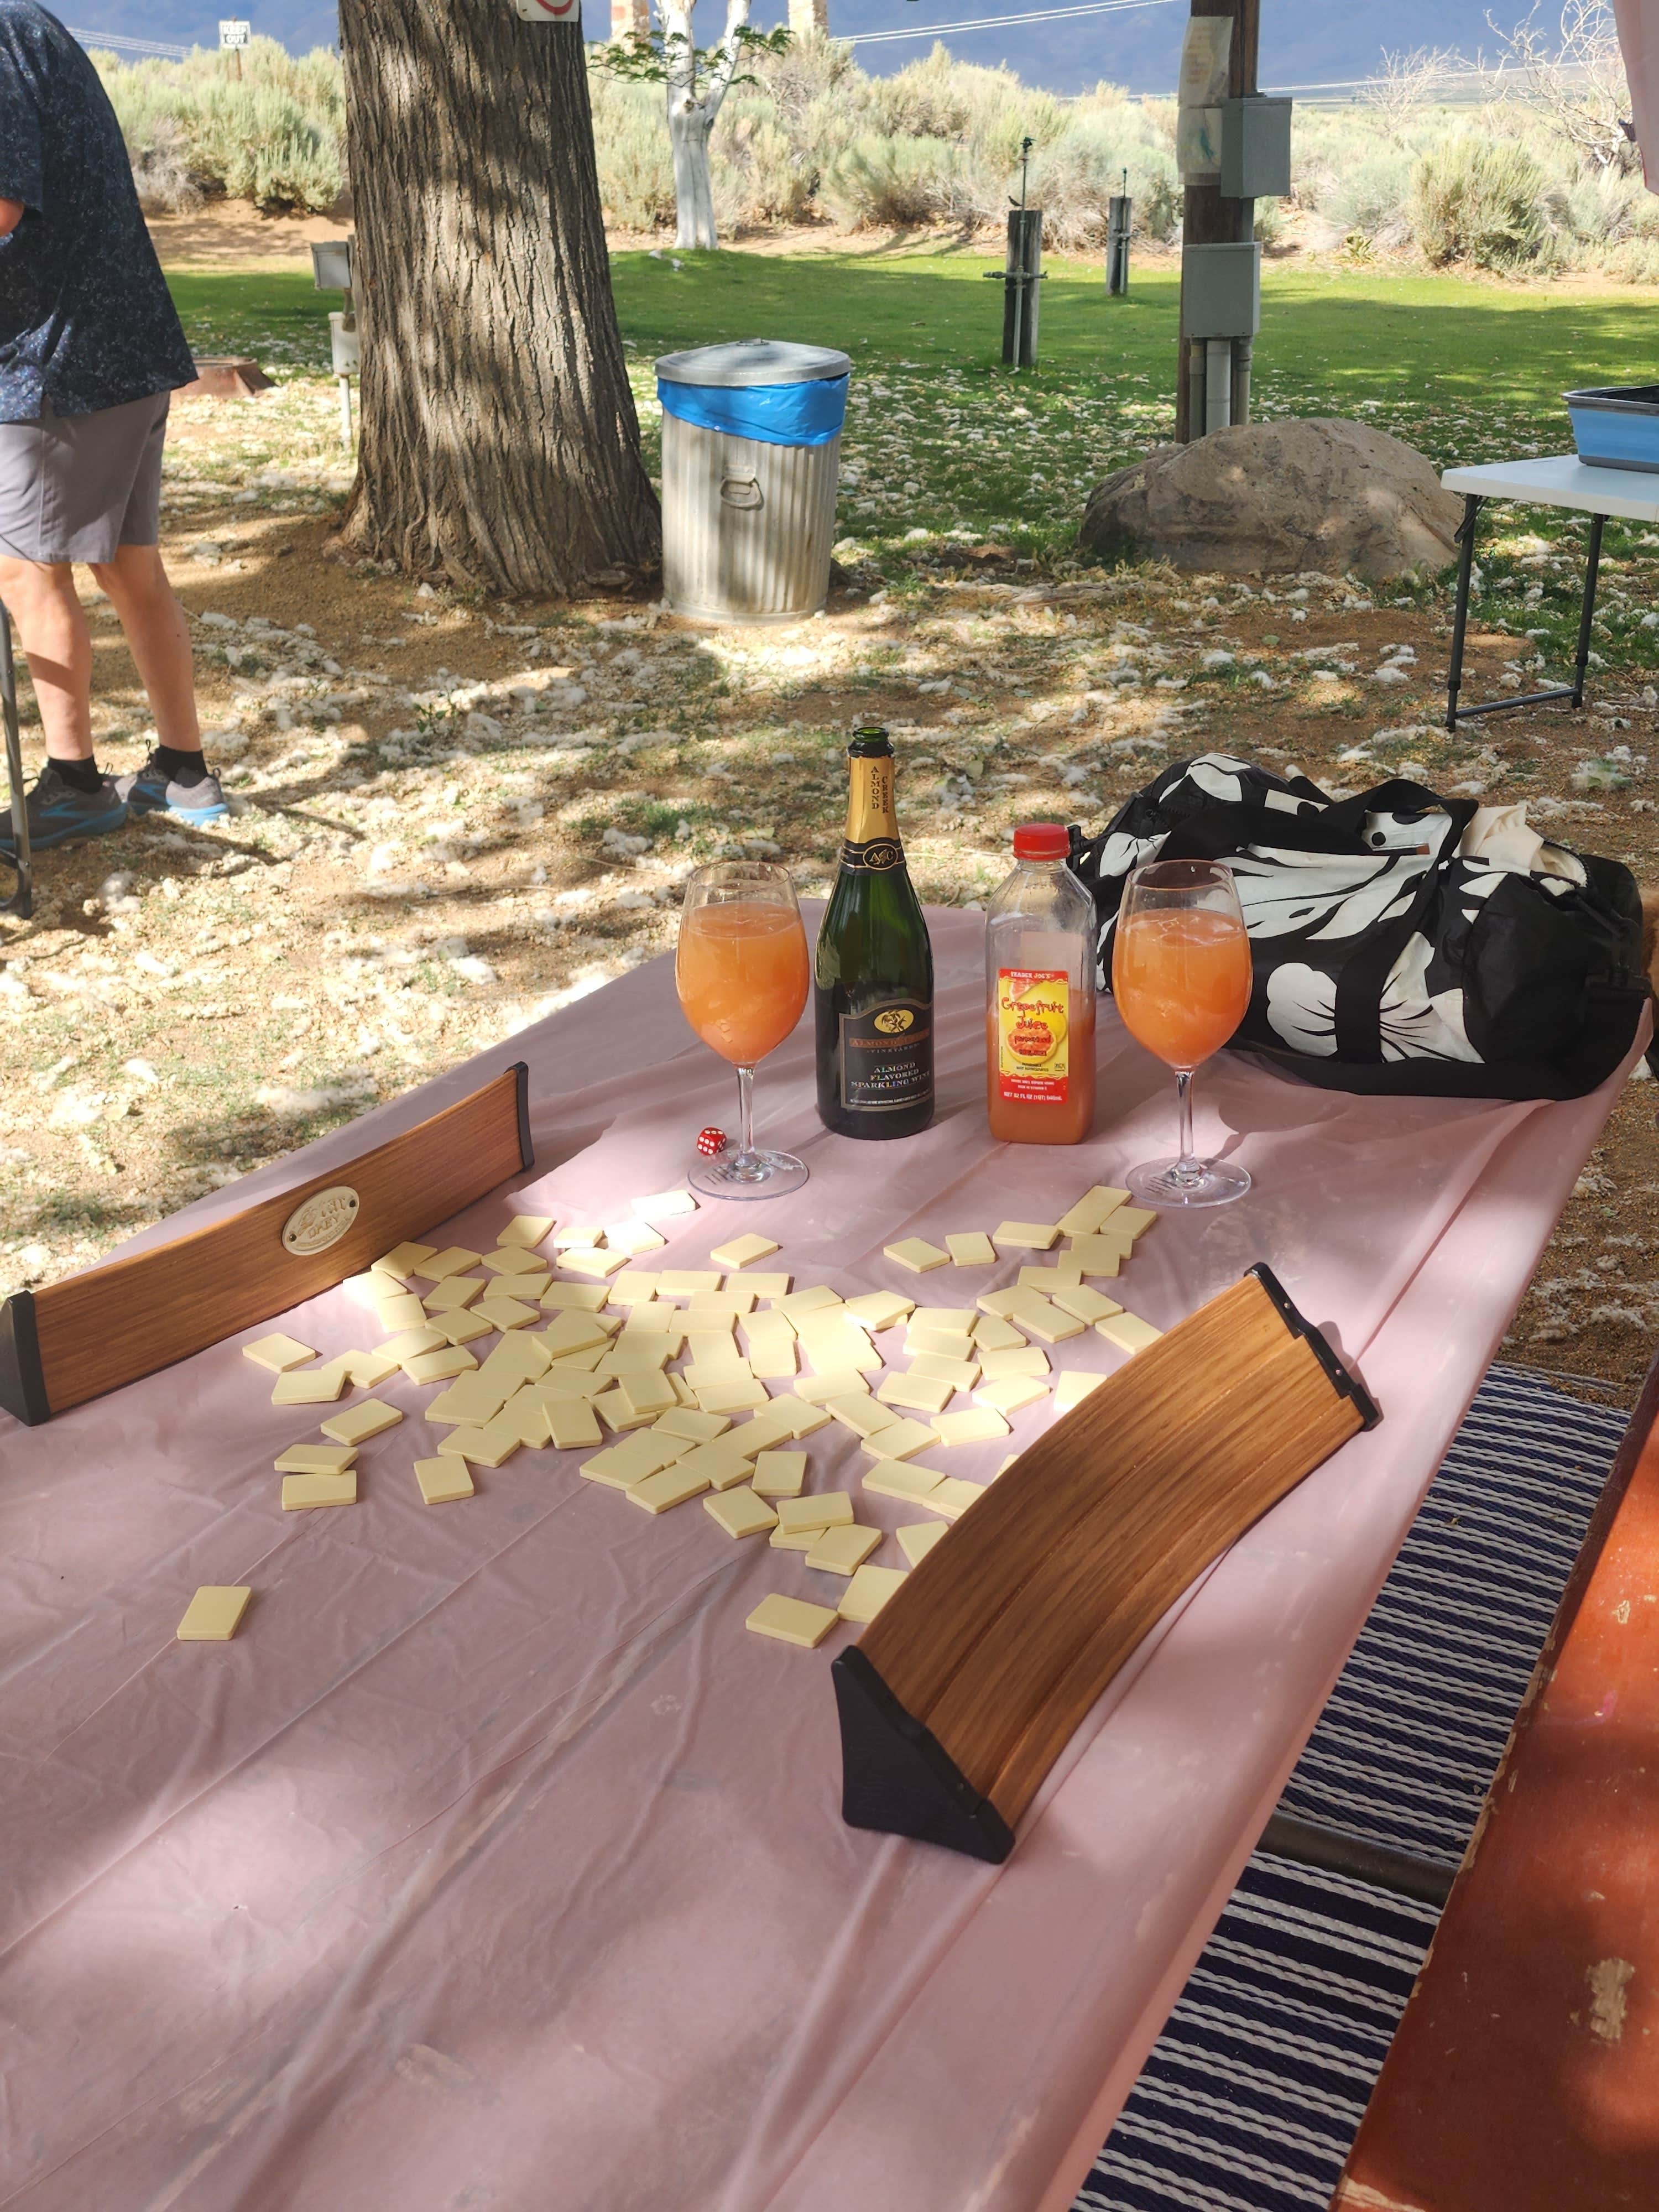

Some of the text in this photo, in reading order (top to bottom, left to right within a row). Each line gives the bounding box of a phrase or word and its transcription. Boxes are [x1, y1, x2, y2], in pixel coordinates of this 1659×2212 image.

[223, 25, 247, 34] KEEP
[226, 35, 244, 44] OUT
[870, 766, 880, 810] ALMOND
[1001, 997, 1064, 1018] Grapefruit
[1016, 1016, 1048, 1030] Juice
[874, 1062, 916, 1073] ALMOND
[870, 1068, 920, 1081] FLAVORED
[851, 1078, 910, 1088] SPARKLING
